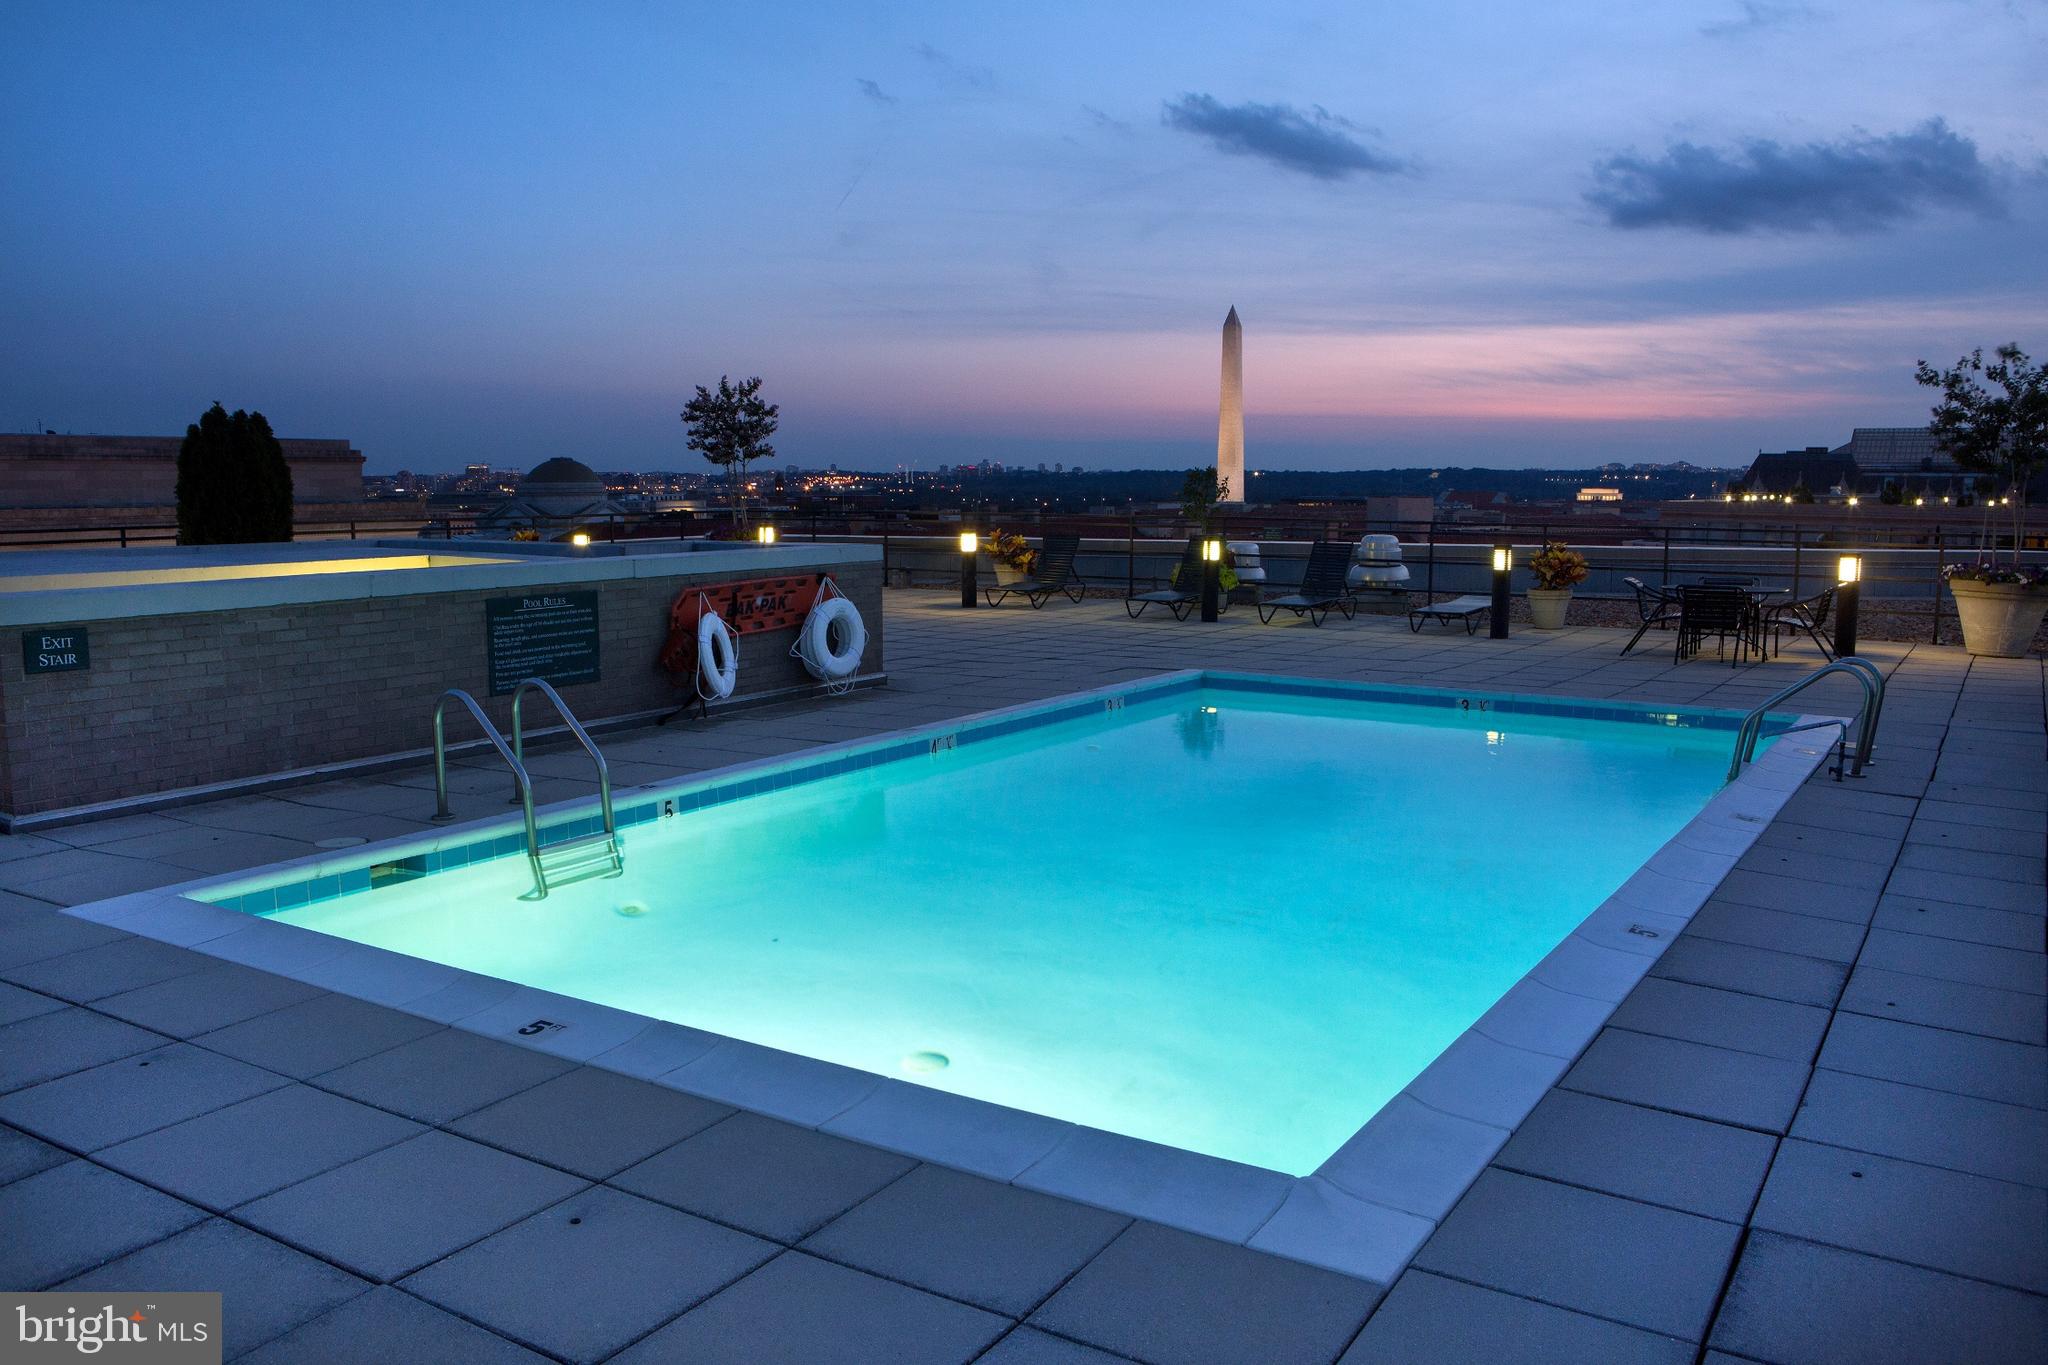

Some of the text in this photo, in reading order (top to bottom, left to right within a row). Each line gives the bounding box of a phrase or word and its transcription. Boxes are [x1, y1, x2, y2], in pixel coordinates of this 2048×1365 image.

[523, 597, 567, 608] POOL RULES
[42, 636, 74, 650] EXIT
[39, 653, 77, 667] STAIR
[664, 800, 673, 818] 5
[518, 1020, 554, 1035] 5
